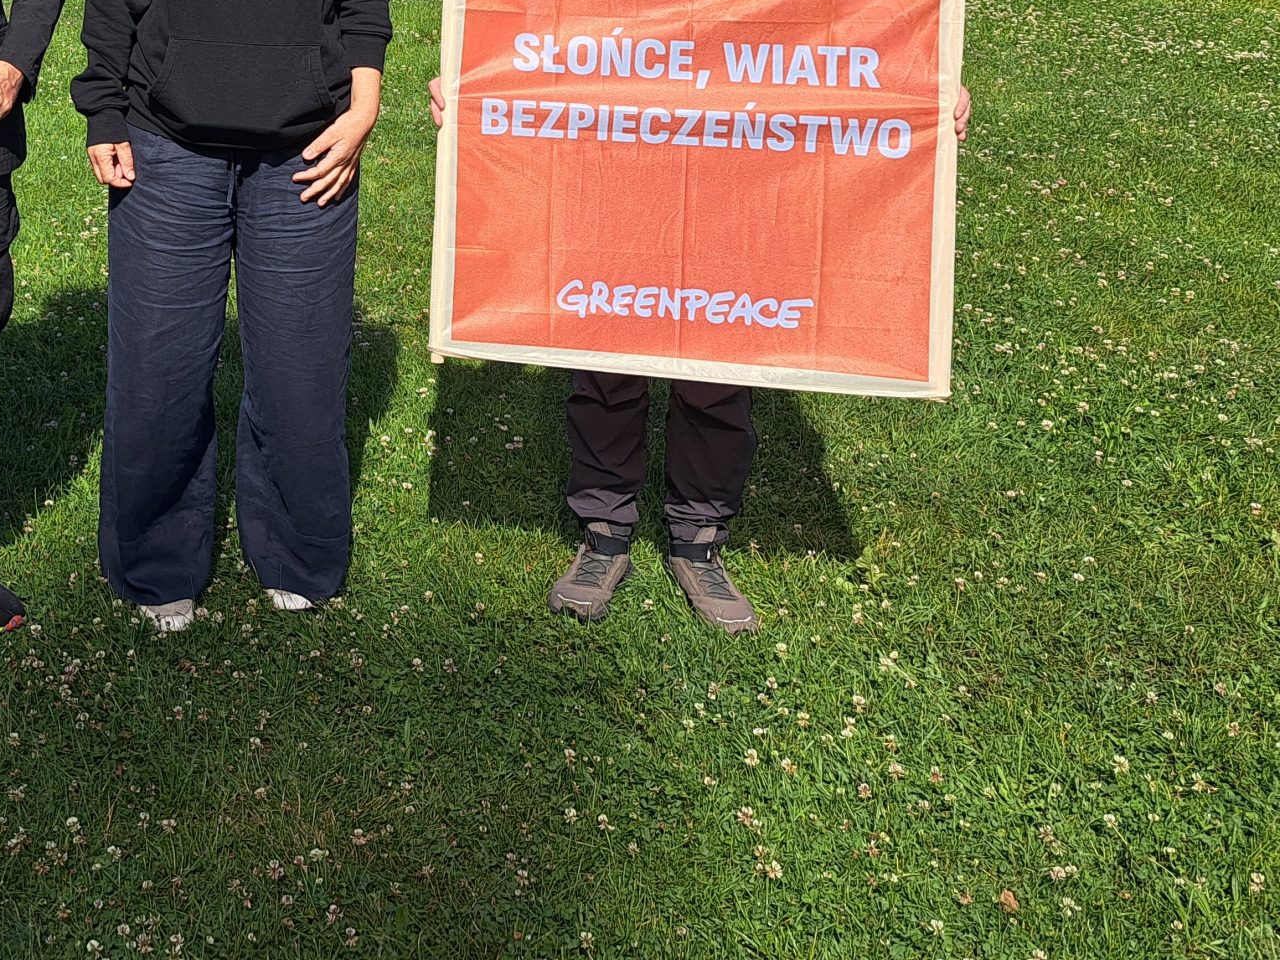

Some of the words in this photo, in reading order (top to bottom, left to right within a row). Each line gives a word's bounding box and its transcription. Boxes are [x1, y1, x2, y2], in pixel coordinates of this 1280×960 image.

[512, 27, 711, 89] SŁOŃCE,
[723, 41, 881, 88] WIATR
[481, 98, 912, 159] BEZPIECZEŃSTWO
[556, 279, 814, 329] GREENPEACE
